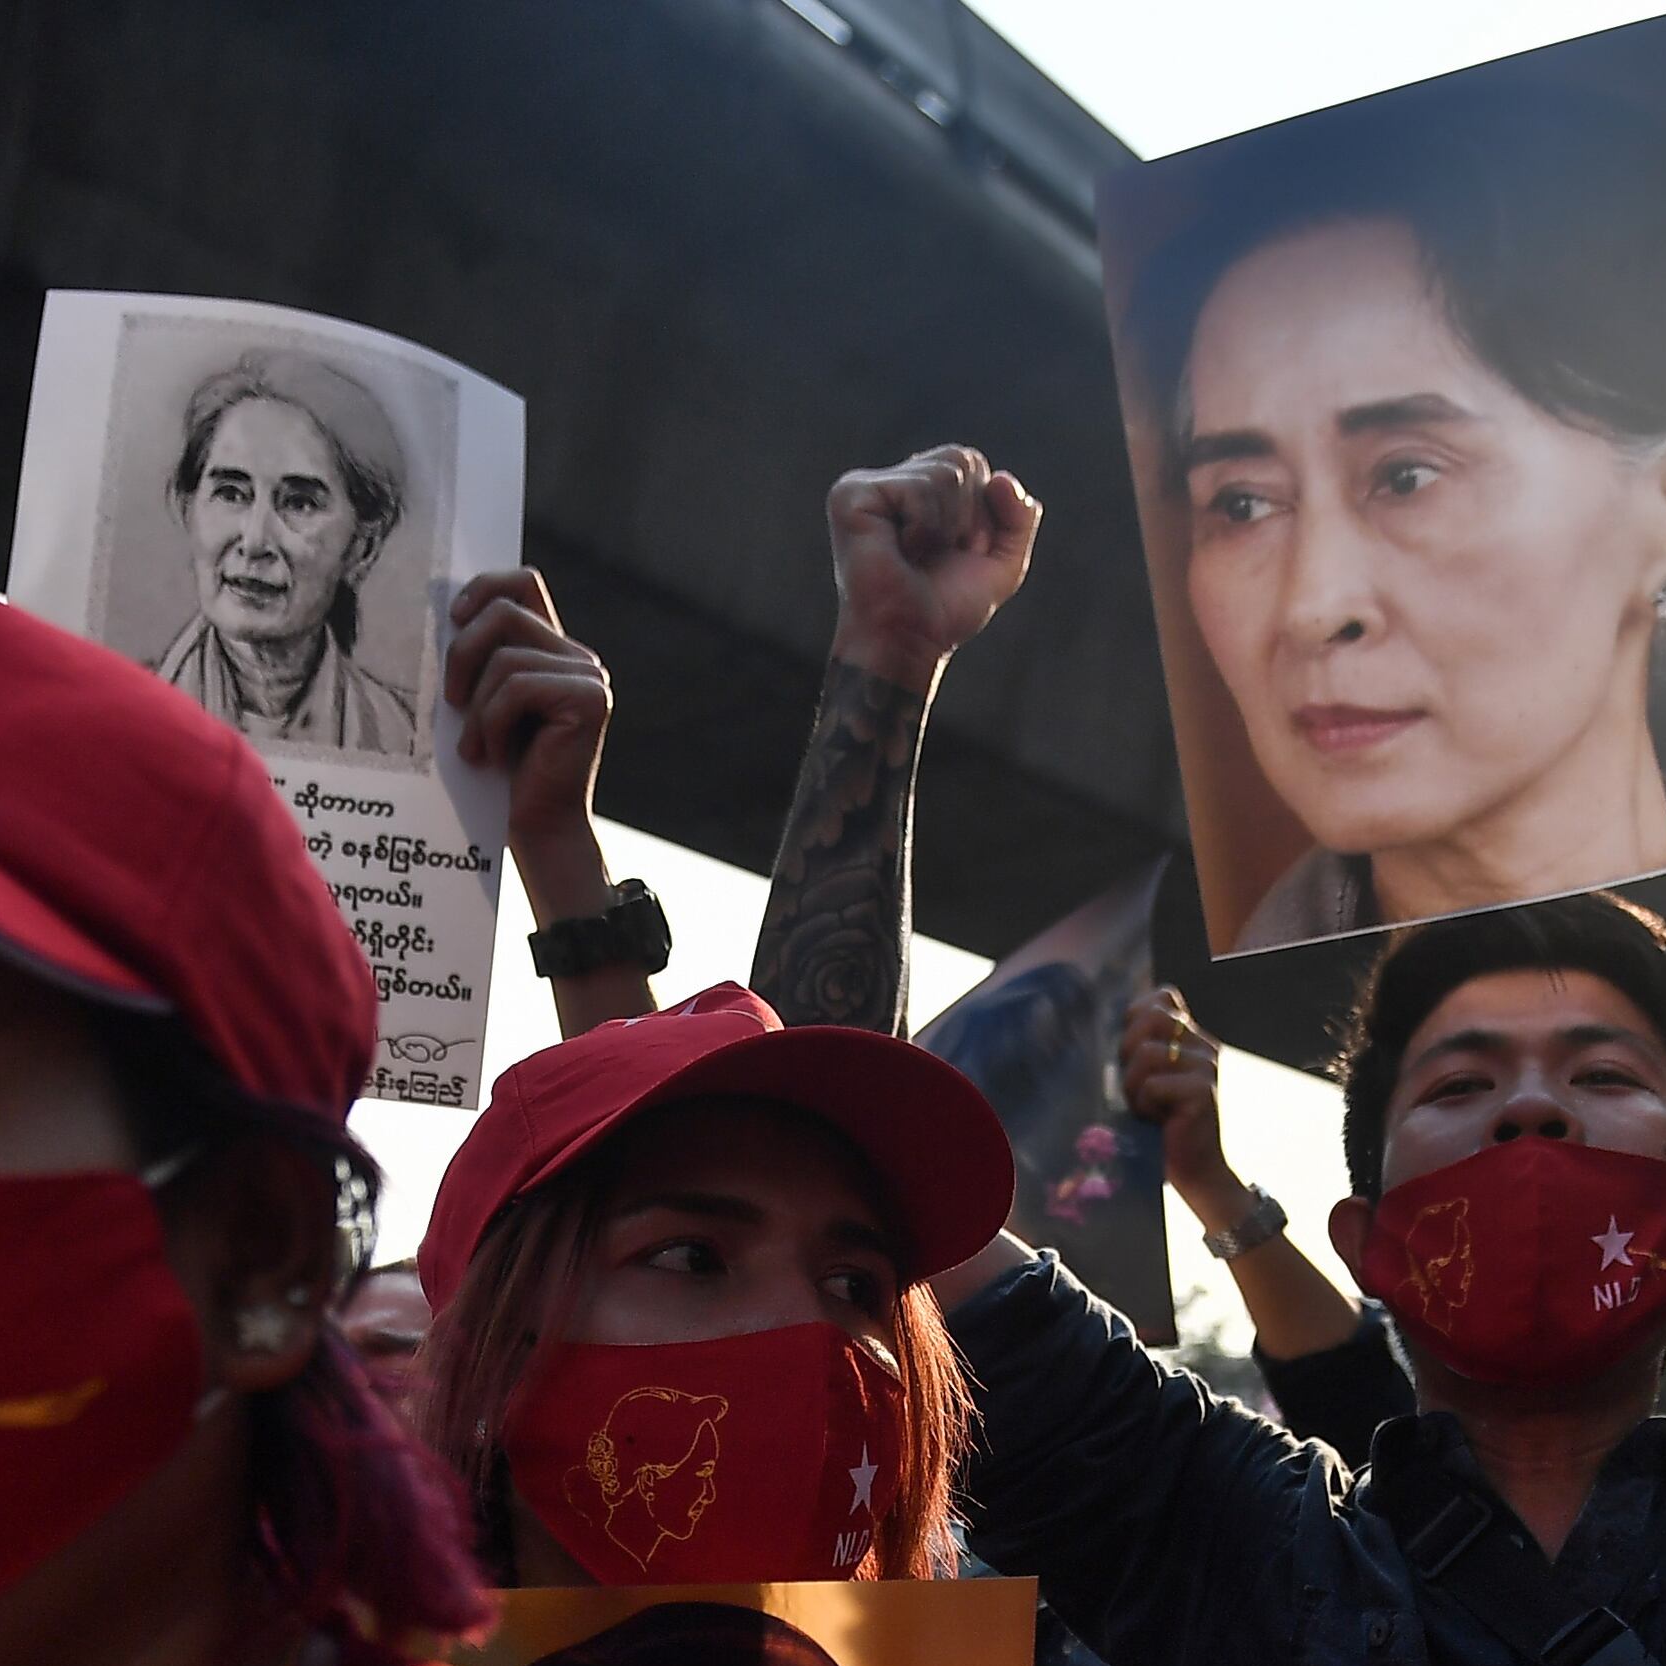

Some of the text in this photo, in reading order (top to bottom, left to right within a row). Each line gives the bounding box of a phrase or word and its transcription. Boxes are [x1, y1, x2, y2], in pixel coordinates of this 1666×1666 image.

[294, 782, 395, 818] ဆိုတာဟာ
[832, 1529, 870, 1567] NLD
